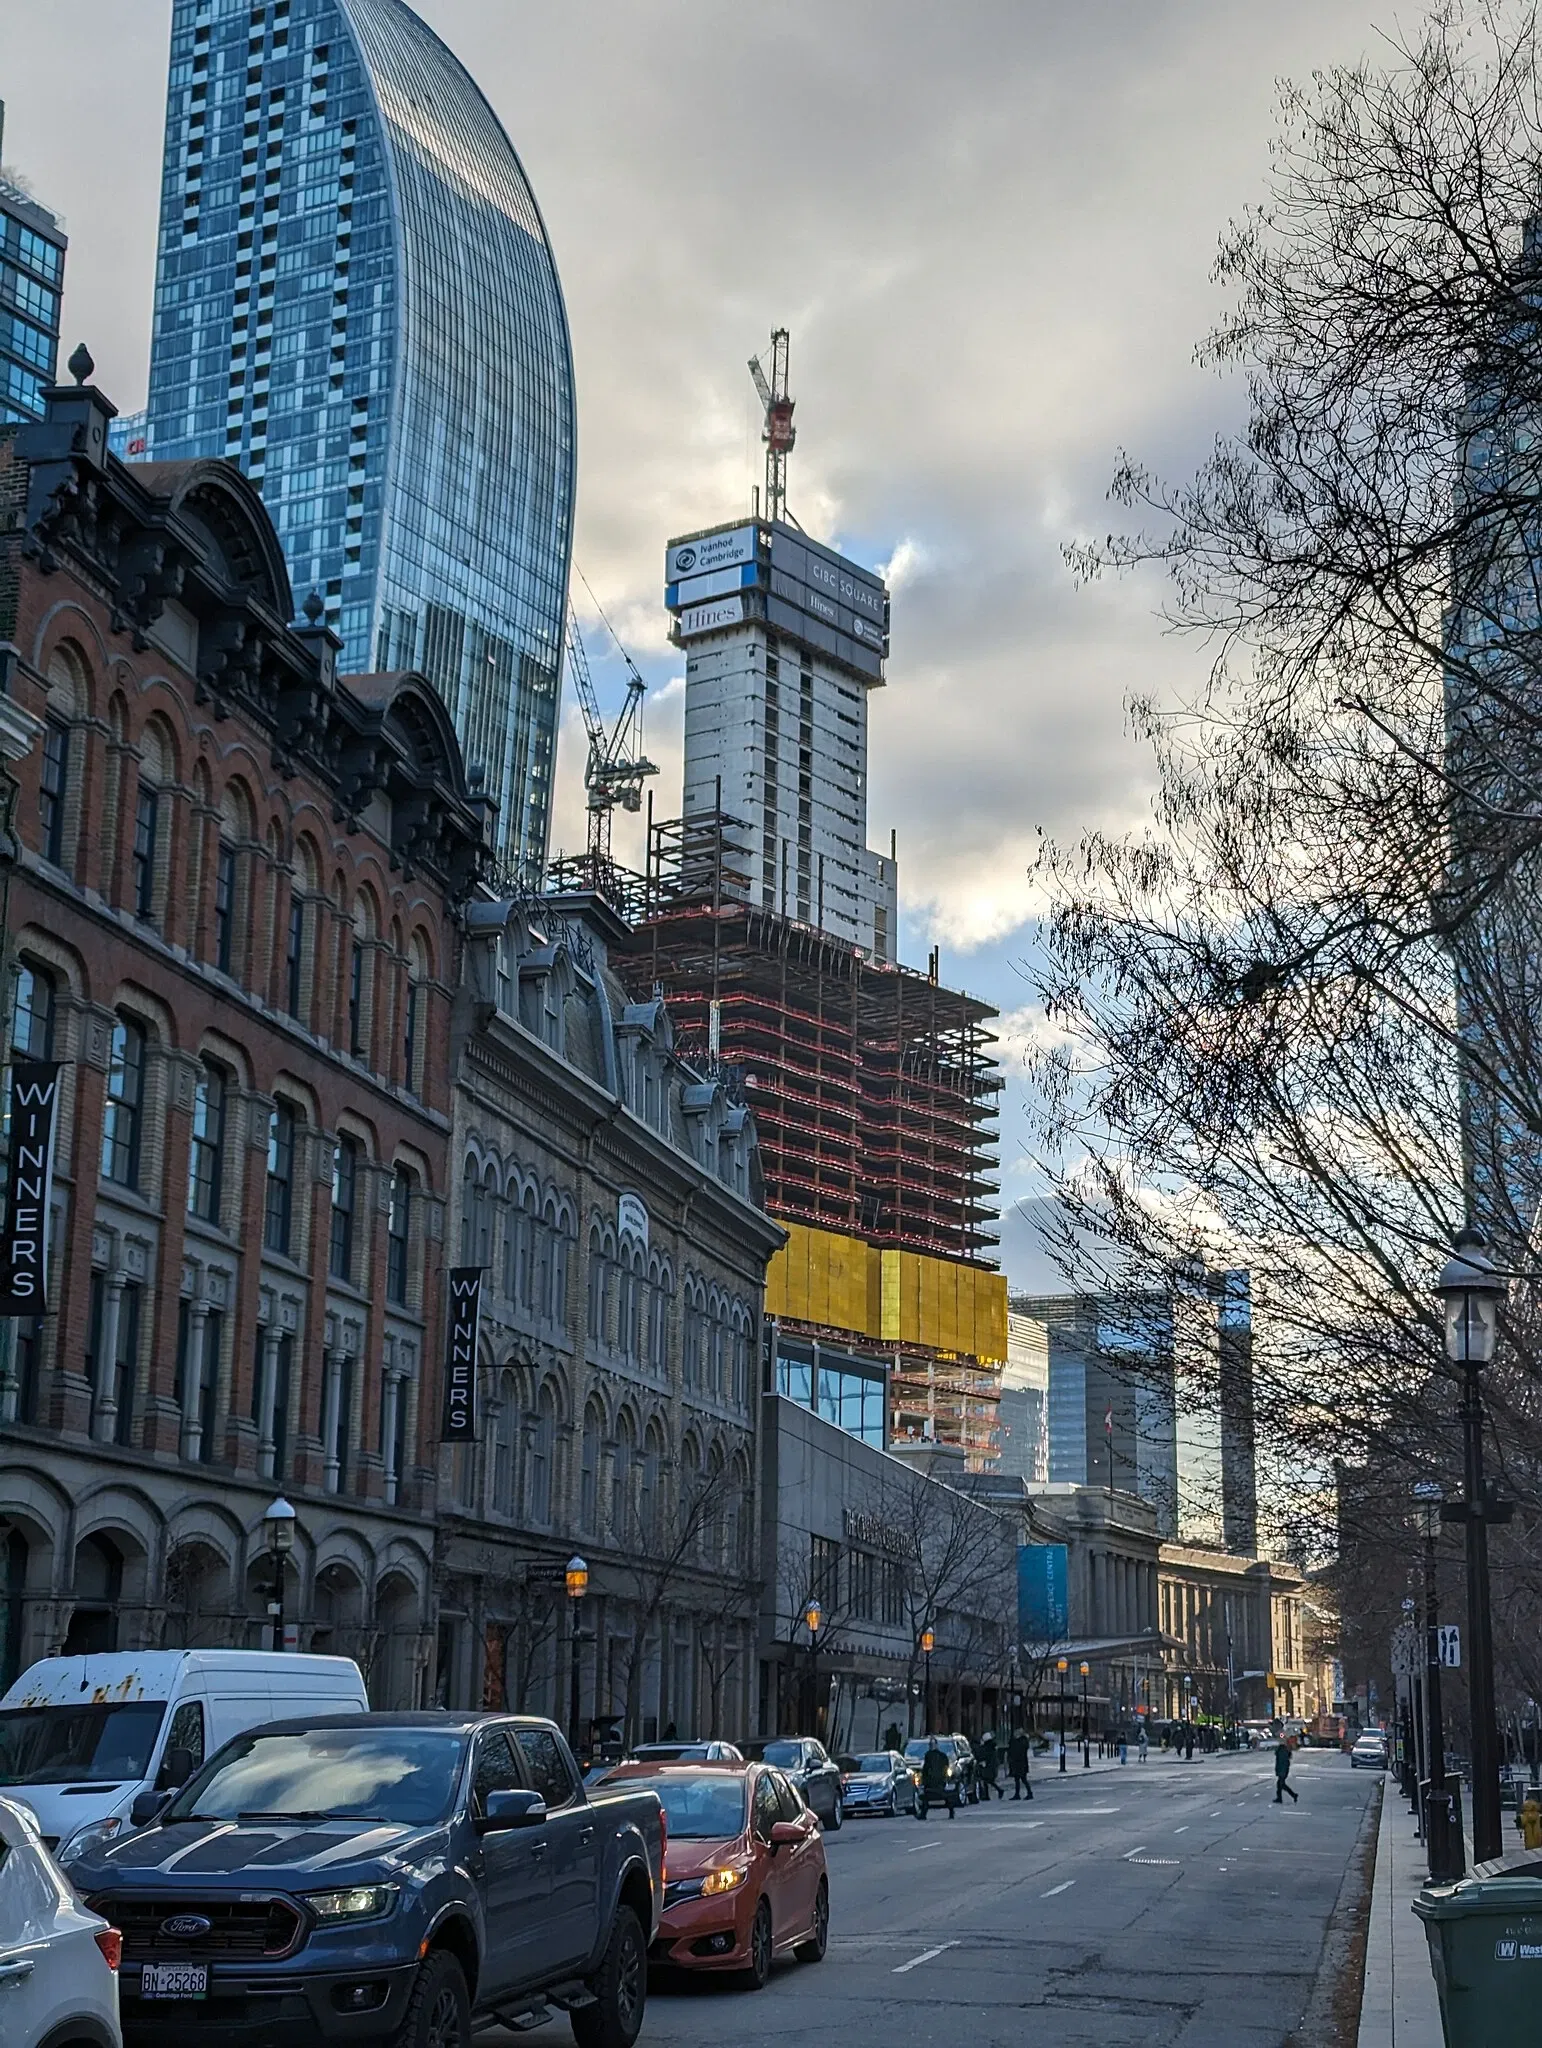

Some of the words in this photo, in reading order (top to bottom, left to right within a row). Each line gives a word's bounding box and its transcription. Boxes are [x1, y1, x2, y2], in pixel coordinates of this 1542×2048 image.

[699, 548, 744, 567] Cambridge
[700, 537, 733, 554] Ivanhoé
[813, 564, 836, 588] CIBC
[838, 580, 880, 612] SQUARE
[809, 594, 836, 618] Hines
[687, 607, 736, 631] Hines
[10, 1082, 54, 1297] WINNERS
[450, 1280, 479, 1428] WINNERS
[170, 1919, 198, 1932] Ford
